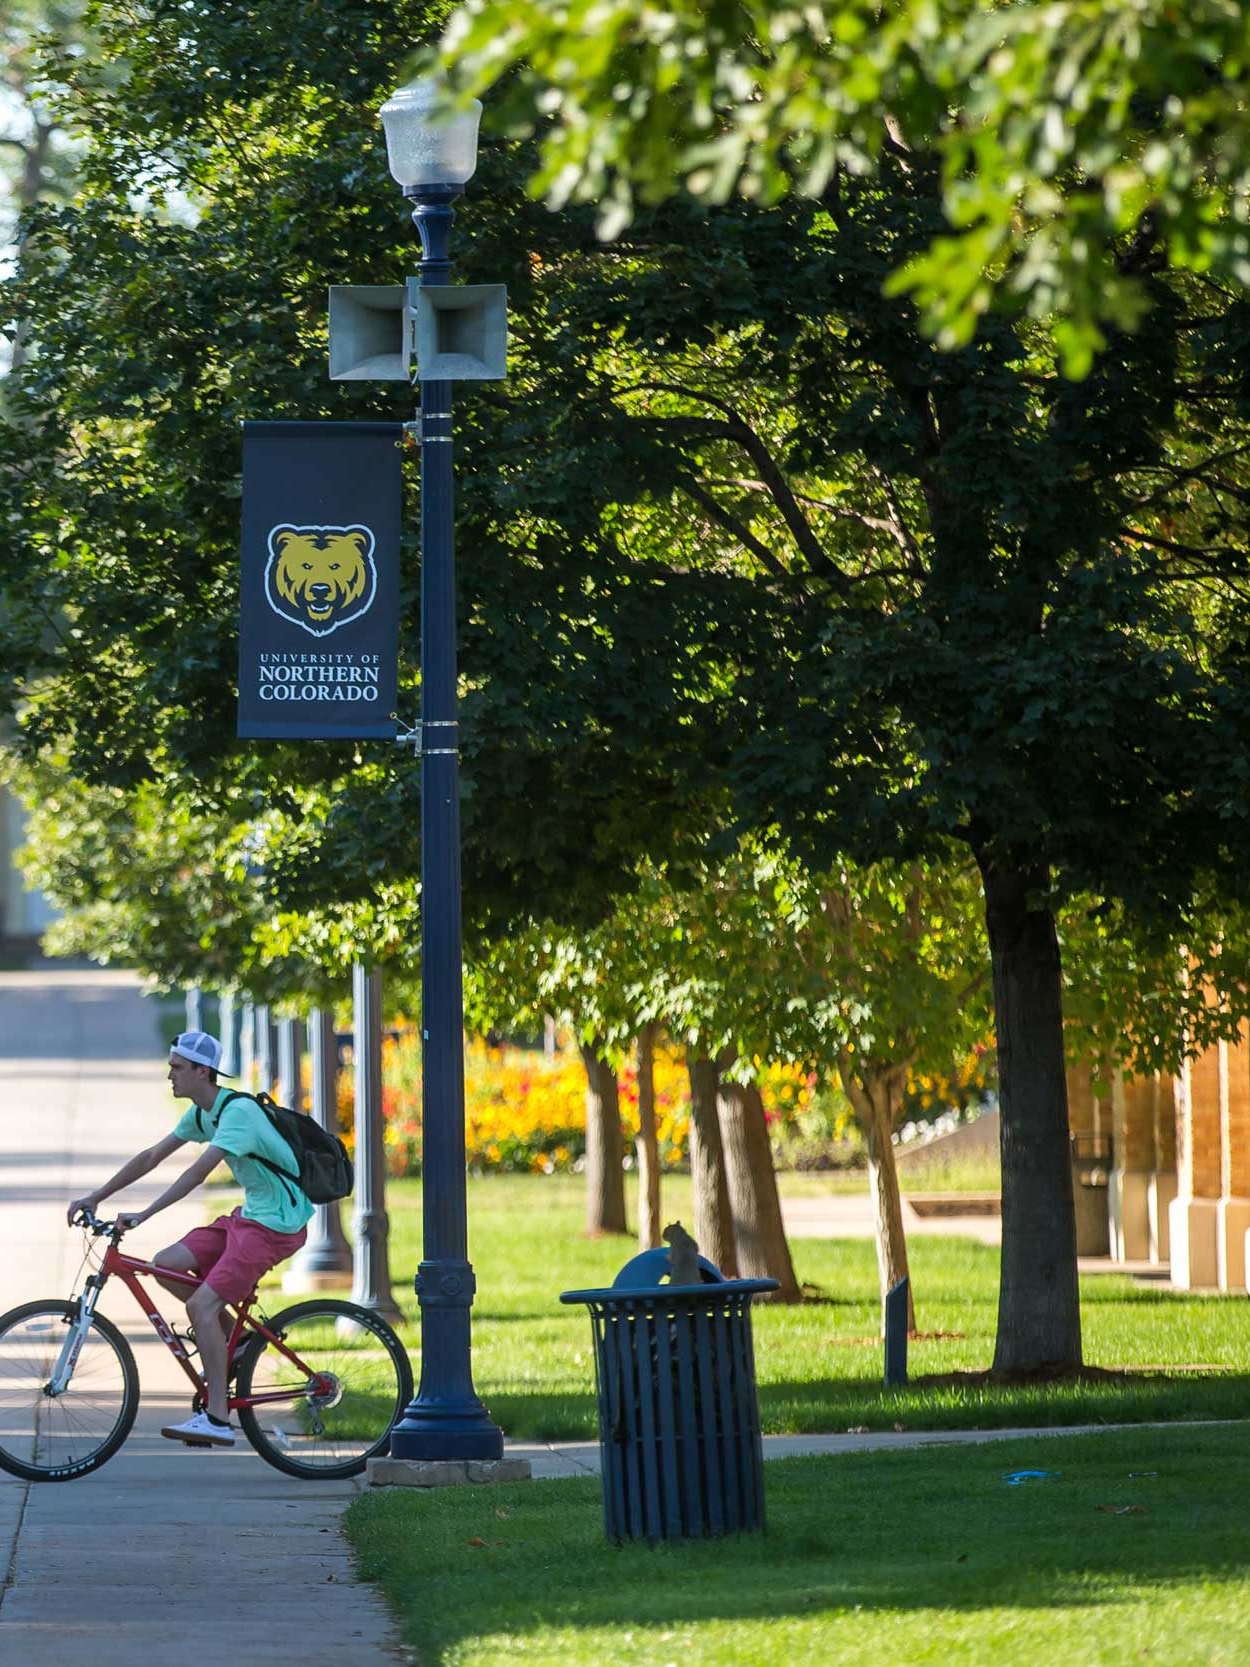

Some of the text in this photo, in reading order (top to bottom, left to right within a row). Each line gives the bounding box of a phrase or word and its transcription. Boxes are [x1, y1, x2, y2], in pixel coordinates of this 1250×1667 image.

[260, 653, 380, 663] UNIVERSITY OF
[258, 665, 380, 682] NORTHERN
[258, 684, 379, 701] COLORADO
